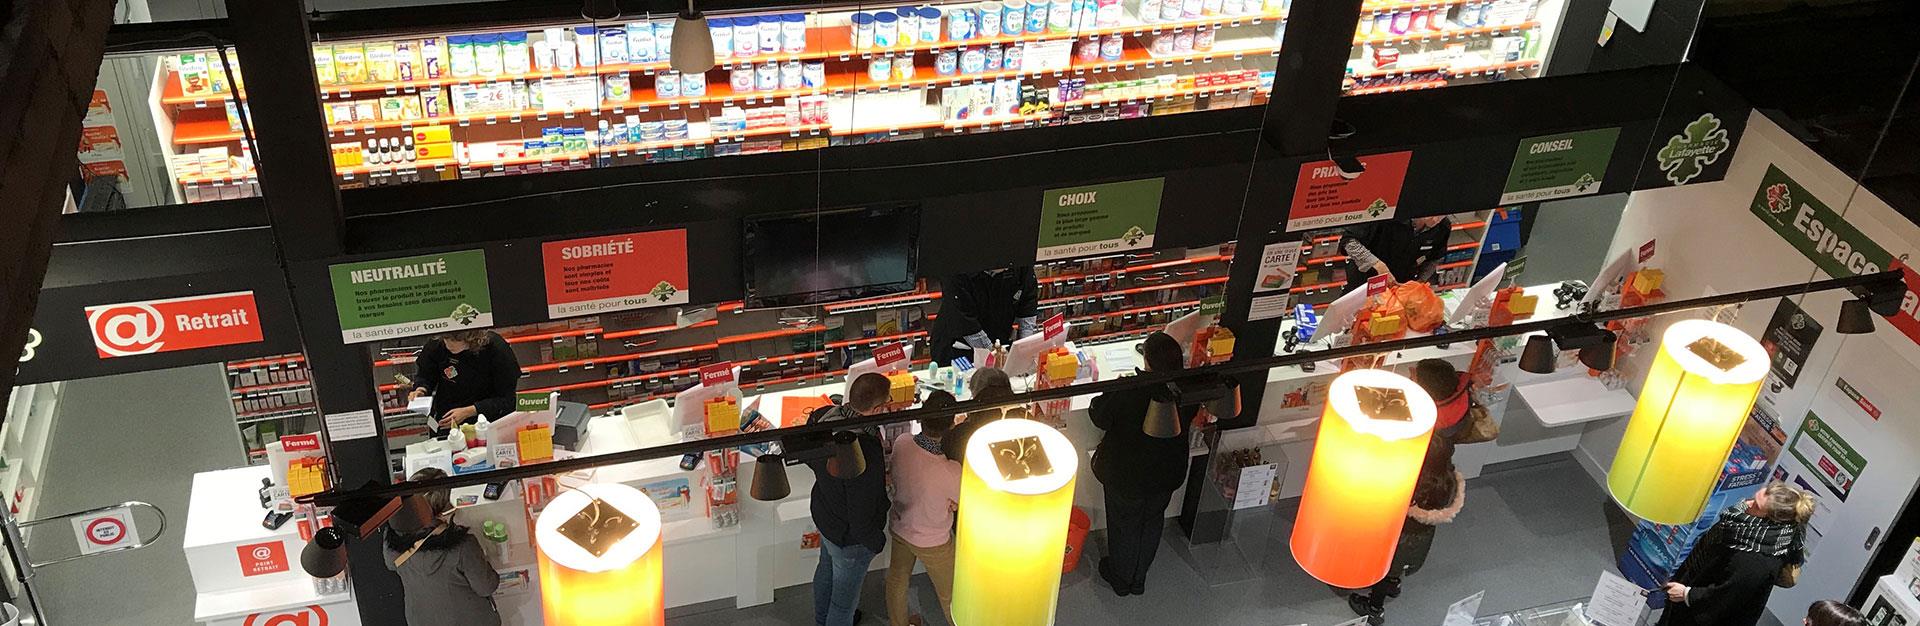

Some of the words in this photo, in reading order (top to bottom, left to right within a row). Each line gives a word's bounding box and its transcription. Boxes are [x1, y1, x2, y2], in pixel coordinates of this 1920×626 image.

[1529, 138, 1574, 155] CONSEIL
[1669, 145, 1716, 159] Lafayette
[1311, 165, 1340, 180] PRIX
[1058, 191, 1097, 207] CHOIX
[1302, 218, 1324, 227] santé
[1325, 216, 1344, 225] pour
[1344, 213, 1363, 221] tous
[561, 238, 635, 260] SOBRIÉTÉ
[1044, 249, 1053, 257] la
[1053, 246, 1077, 256] santé
[1078, 244, 1098, 254] pour
[1099, 241, 1119, 250] tous
[1264, 253, 1291, 265] CARTE
[350, 257, 448, 284] NEUTRALITÉ
[557, 305, 567, 314] la
[568, 302, 596, 313] santé
[598, 299, 622, 311] pour
[623, 296, 648, 305] tous
[1201, 300, 1225, 310] Ouvert
[175, 308, 249, 332] Retrait
[352, 331, 363, 339] la
[365, 327, 394, 338] santé
[396, 324, 420, 336] pour
[423, 320, 449, 330] tous
[876, 347, 901, 361] Fermé
[703, 367, 730, 380] Fermé
[518, 397, 548, 406] Ouvert
[285, 439, 316, 448] Fermé
[1731, 473, 1757, 483] STRESS
[252, 564, 280, 573] RETRAIT
[255, 560, 274, 568] POINT
